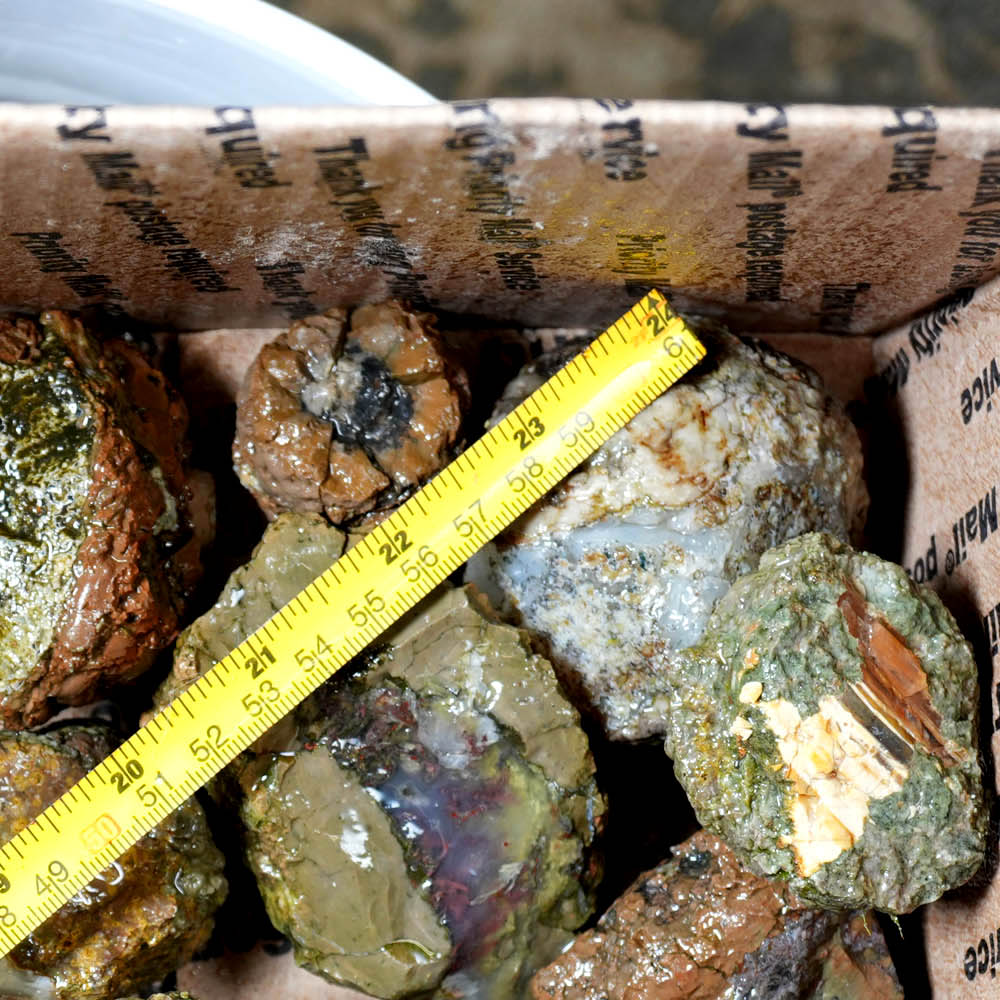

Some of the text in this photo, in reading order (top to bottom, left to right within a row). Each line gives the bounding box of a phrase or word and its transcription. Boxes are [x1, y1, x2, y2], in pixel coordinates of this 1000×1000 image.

[203, 103, 294, 189] quired
[882, 104, 943, 193] quired
[34, 860, 69, 897] 49
[136, 770, 175, 809] 51
[189, 724, 229, 763] 52
[241, 679, 281, 718] 53
[294, 634, 334, 674] 54
[347, 588, 386, 628] 55
[400, 545, 439, 583] 56
[452, 498, 488, 538] 57
[505, 456, 544, 493] 58
[559, 410, 596, 448] 59
[110, 759, 145, 795] 20
[244, 646, 278, 681] 21
[378, 530, 414, 566] 22
[512, 416, 546, 452] 23
